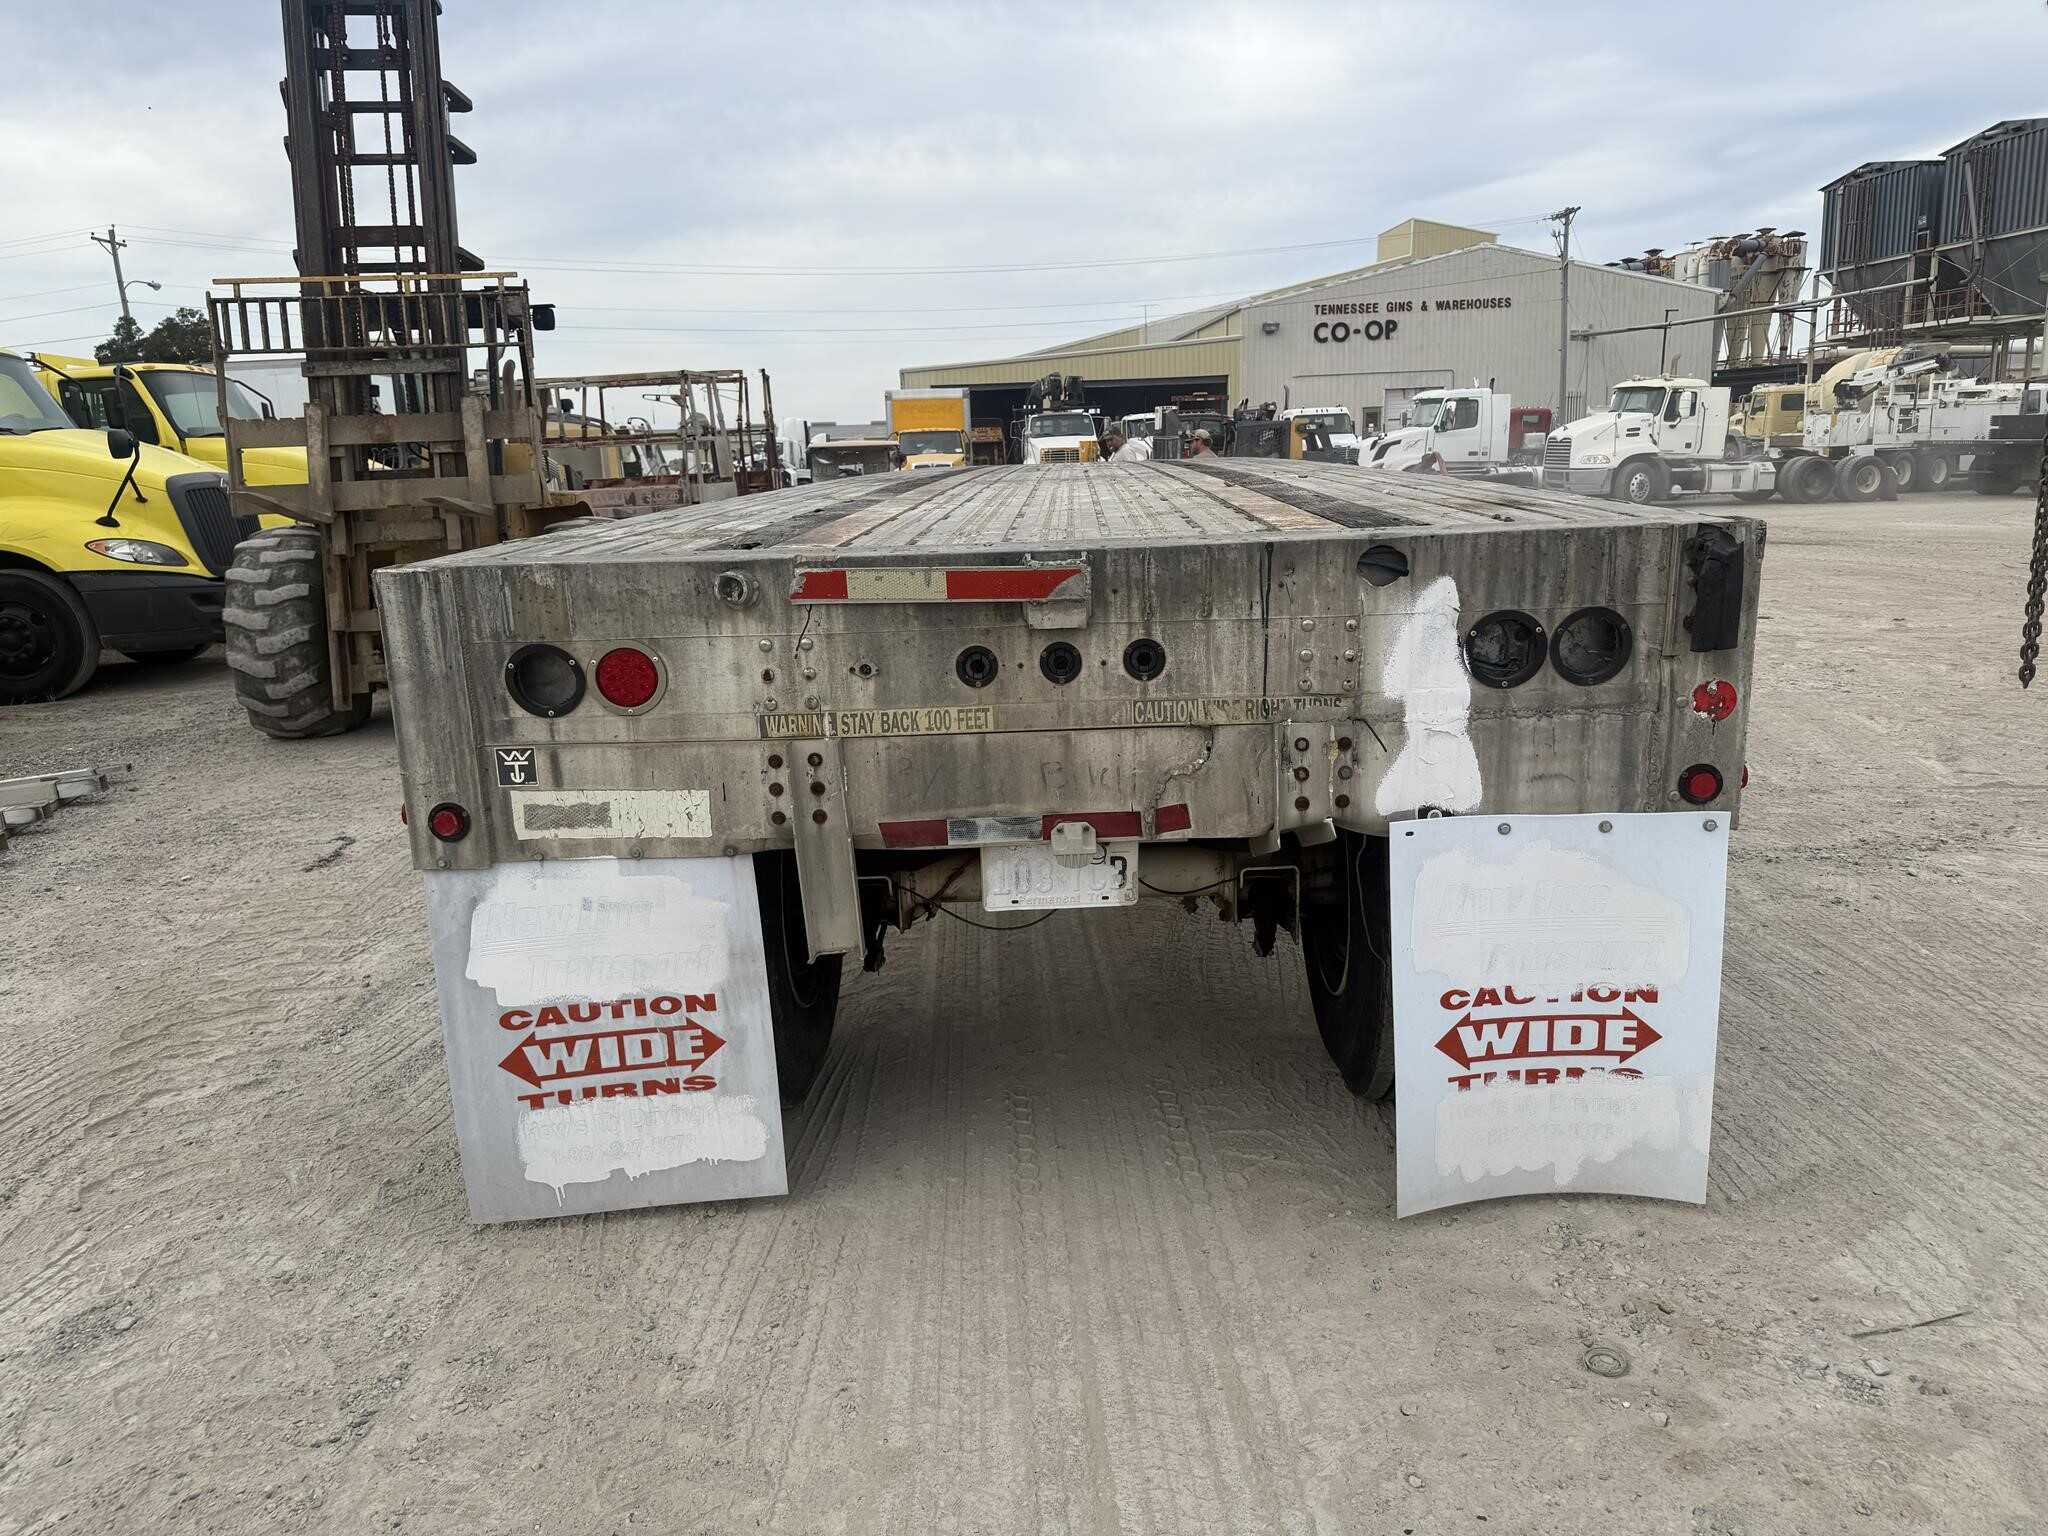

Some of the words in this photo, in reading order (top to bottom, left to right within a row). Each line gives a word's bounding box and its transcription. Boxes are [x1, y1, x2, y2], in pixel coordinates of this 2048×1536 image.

[1314, 302, 1379, 316] TENNESSEE
[1386, 300, 1413, 313] GINS
[1420, 300, 1429, 312] &
[1435, 297, 1512, 311] WAREHOUSES
[1313, 319, 1398, 344] CO-OP
[841, 712, 875, 735] STAY
[880, 711, 920, 734] BACK
[925, 708, 950, 732] 100
[957, 707, 990, 731] FEET
[1134, 700, 1200, 724] CAUTION
[1439, 982, 1659, 1011] CAUION
[499, 993, 718, 1031] CAUTION
[521, 1029, 706, 1077] WIDE
[1456, 1019, 1639, 1058] WIDE
[517, 1075, 718, 1111] TURNS
